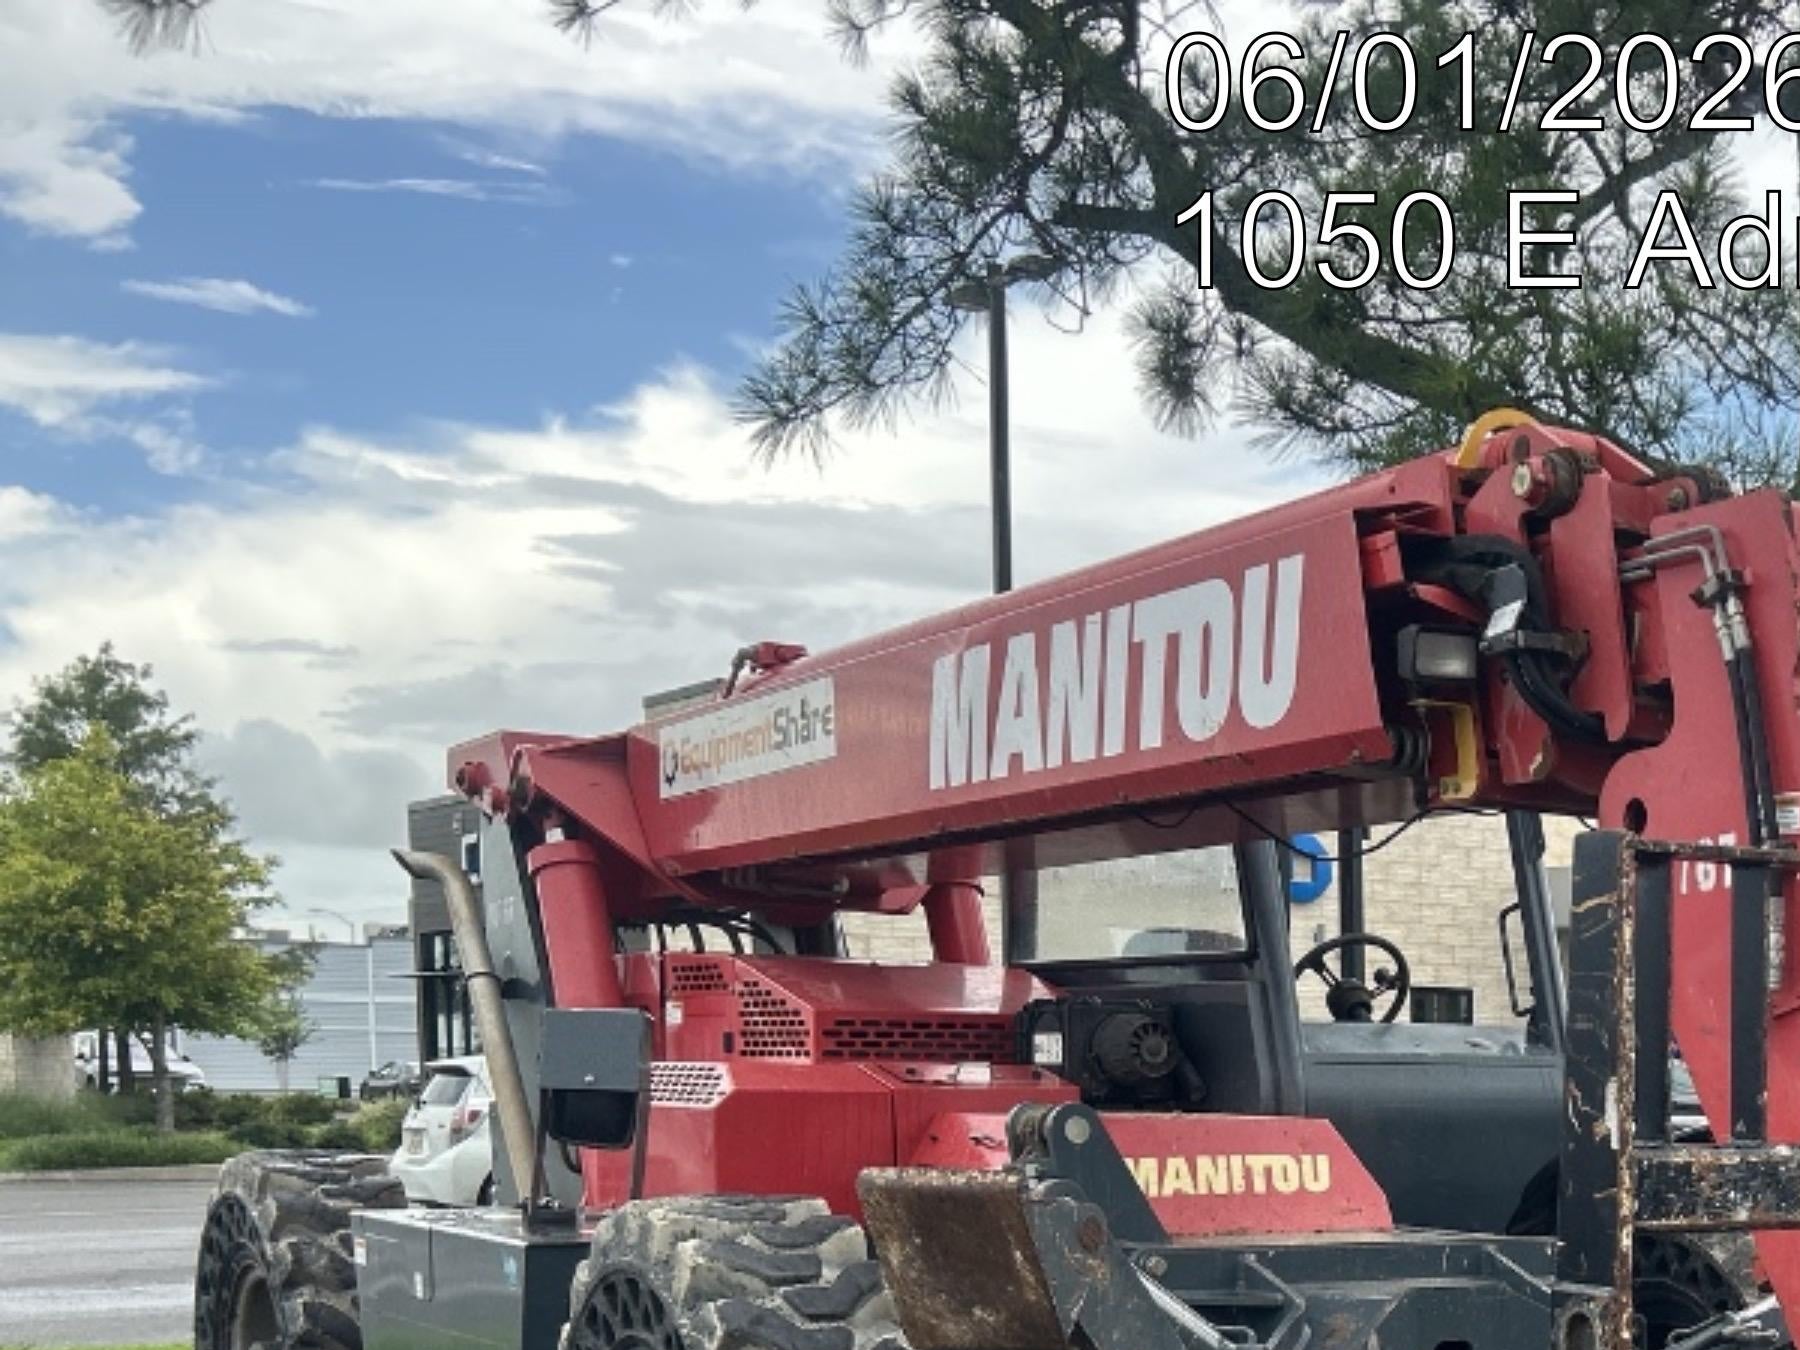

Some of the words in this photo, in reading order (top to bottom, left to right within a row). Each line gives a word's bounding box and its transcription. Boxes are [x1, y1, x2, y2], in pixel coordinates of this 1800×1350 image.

[928, 552, 1305, 791] MANITOU
[680, 697, 834, 780] EquipmentShare
[1122, 1153, 1332, 1198] MANITOU
